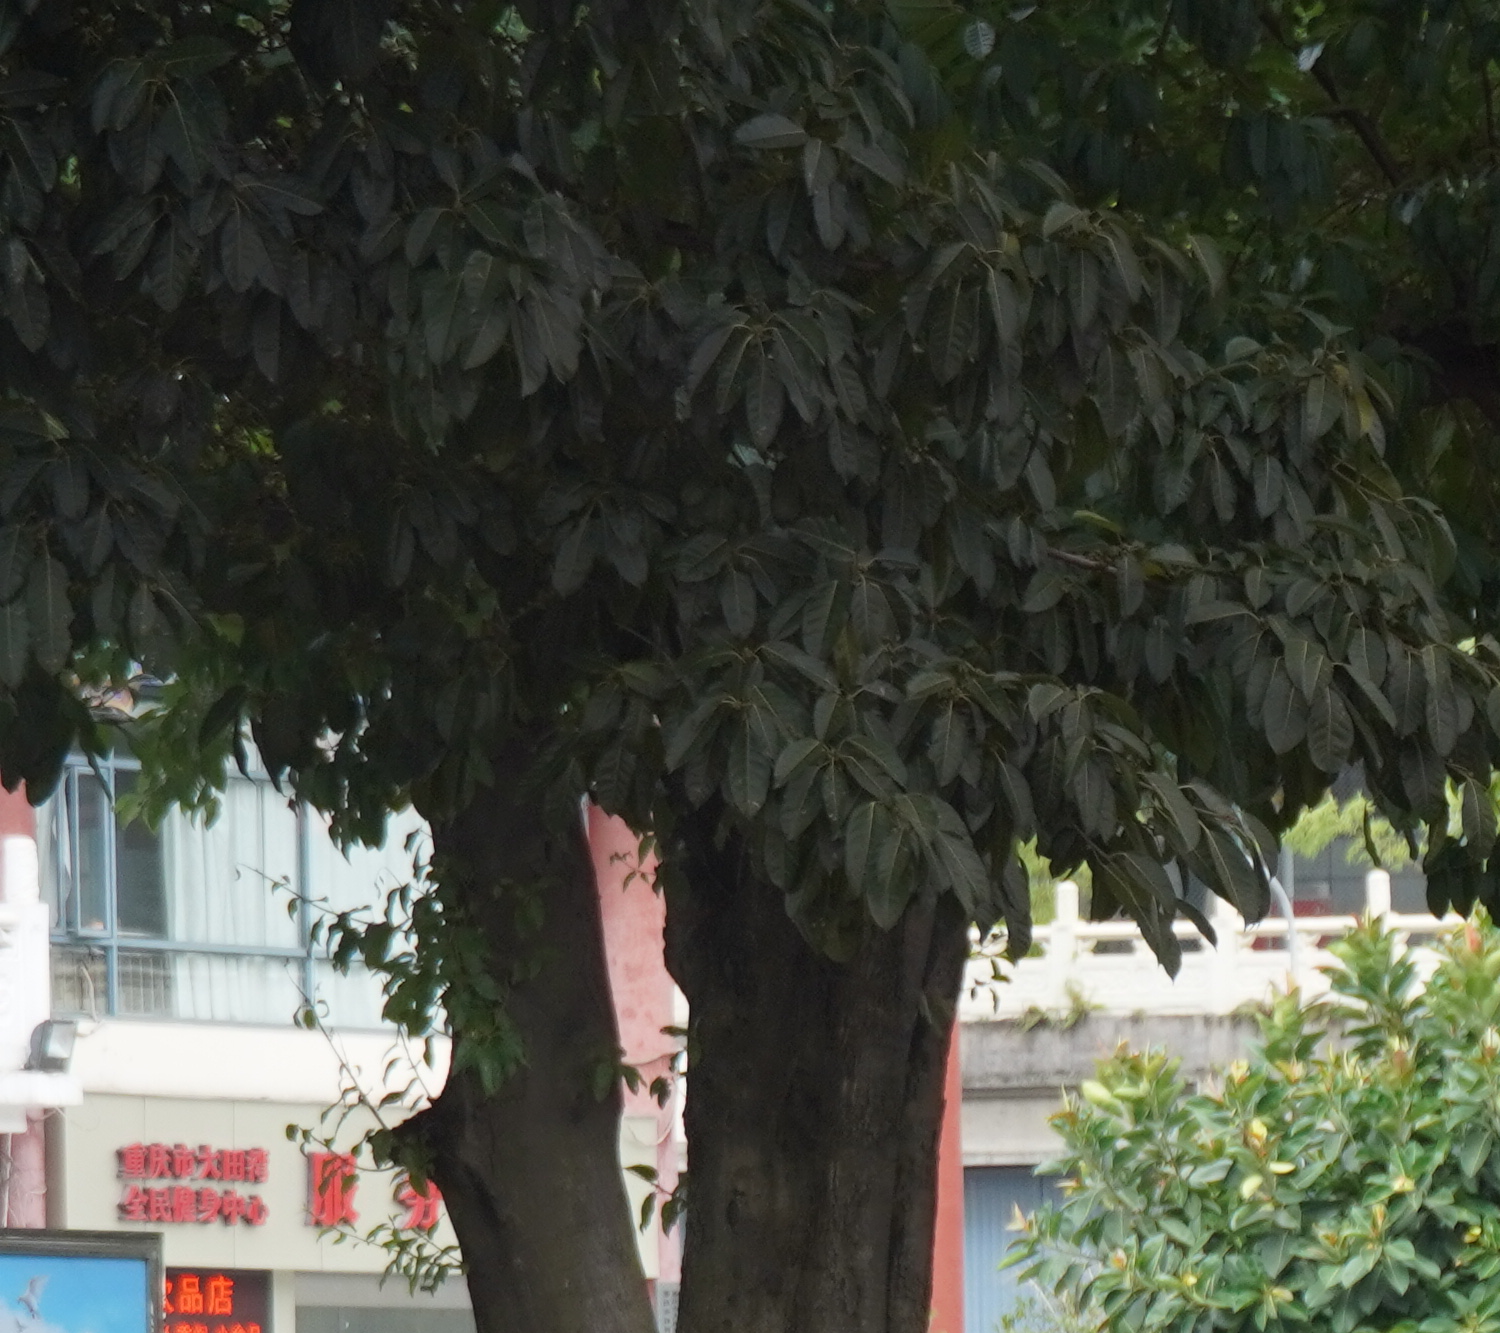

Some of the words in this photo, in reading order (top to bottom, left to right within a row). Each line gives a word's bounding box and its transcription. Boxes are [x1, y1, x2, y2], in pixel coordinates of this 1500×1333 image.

[117, 1142, 270, 1183] 重庆市大田湾
[118, 1184, 269, 1226] 全民健身中心
